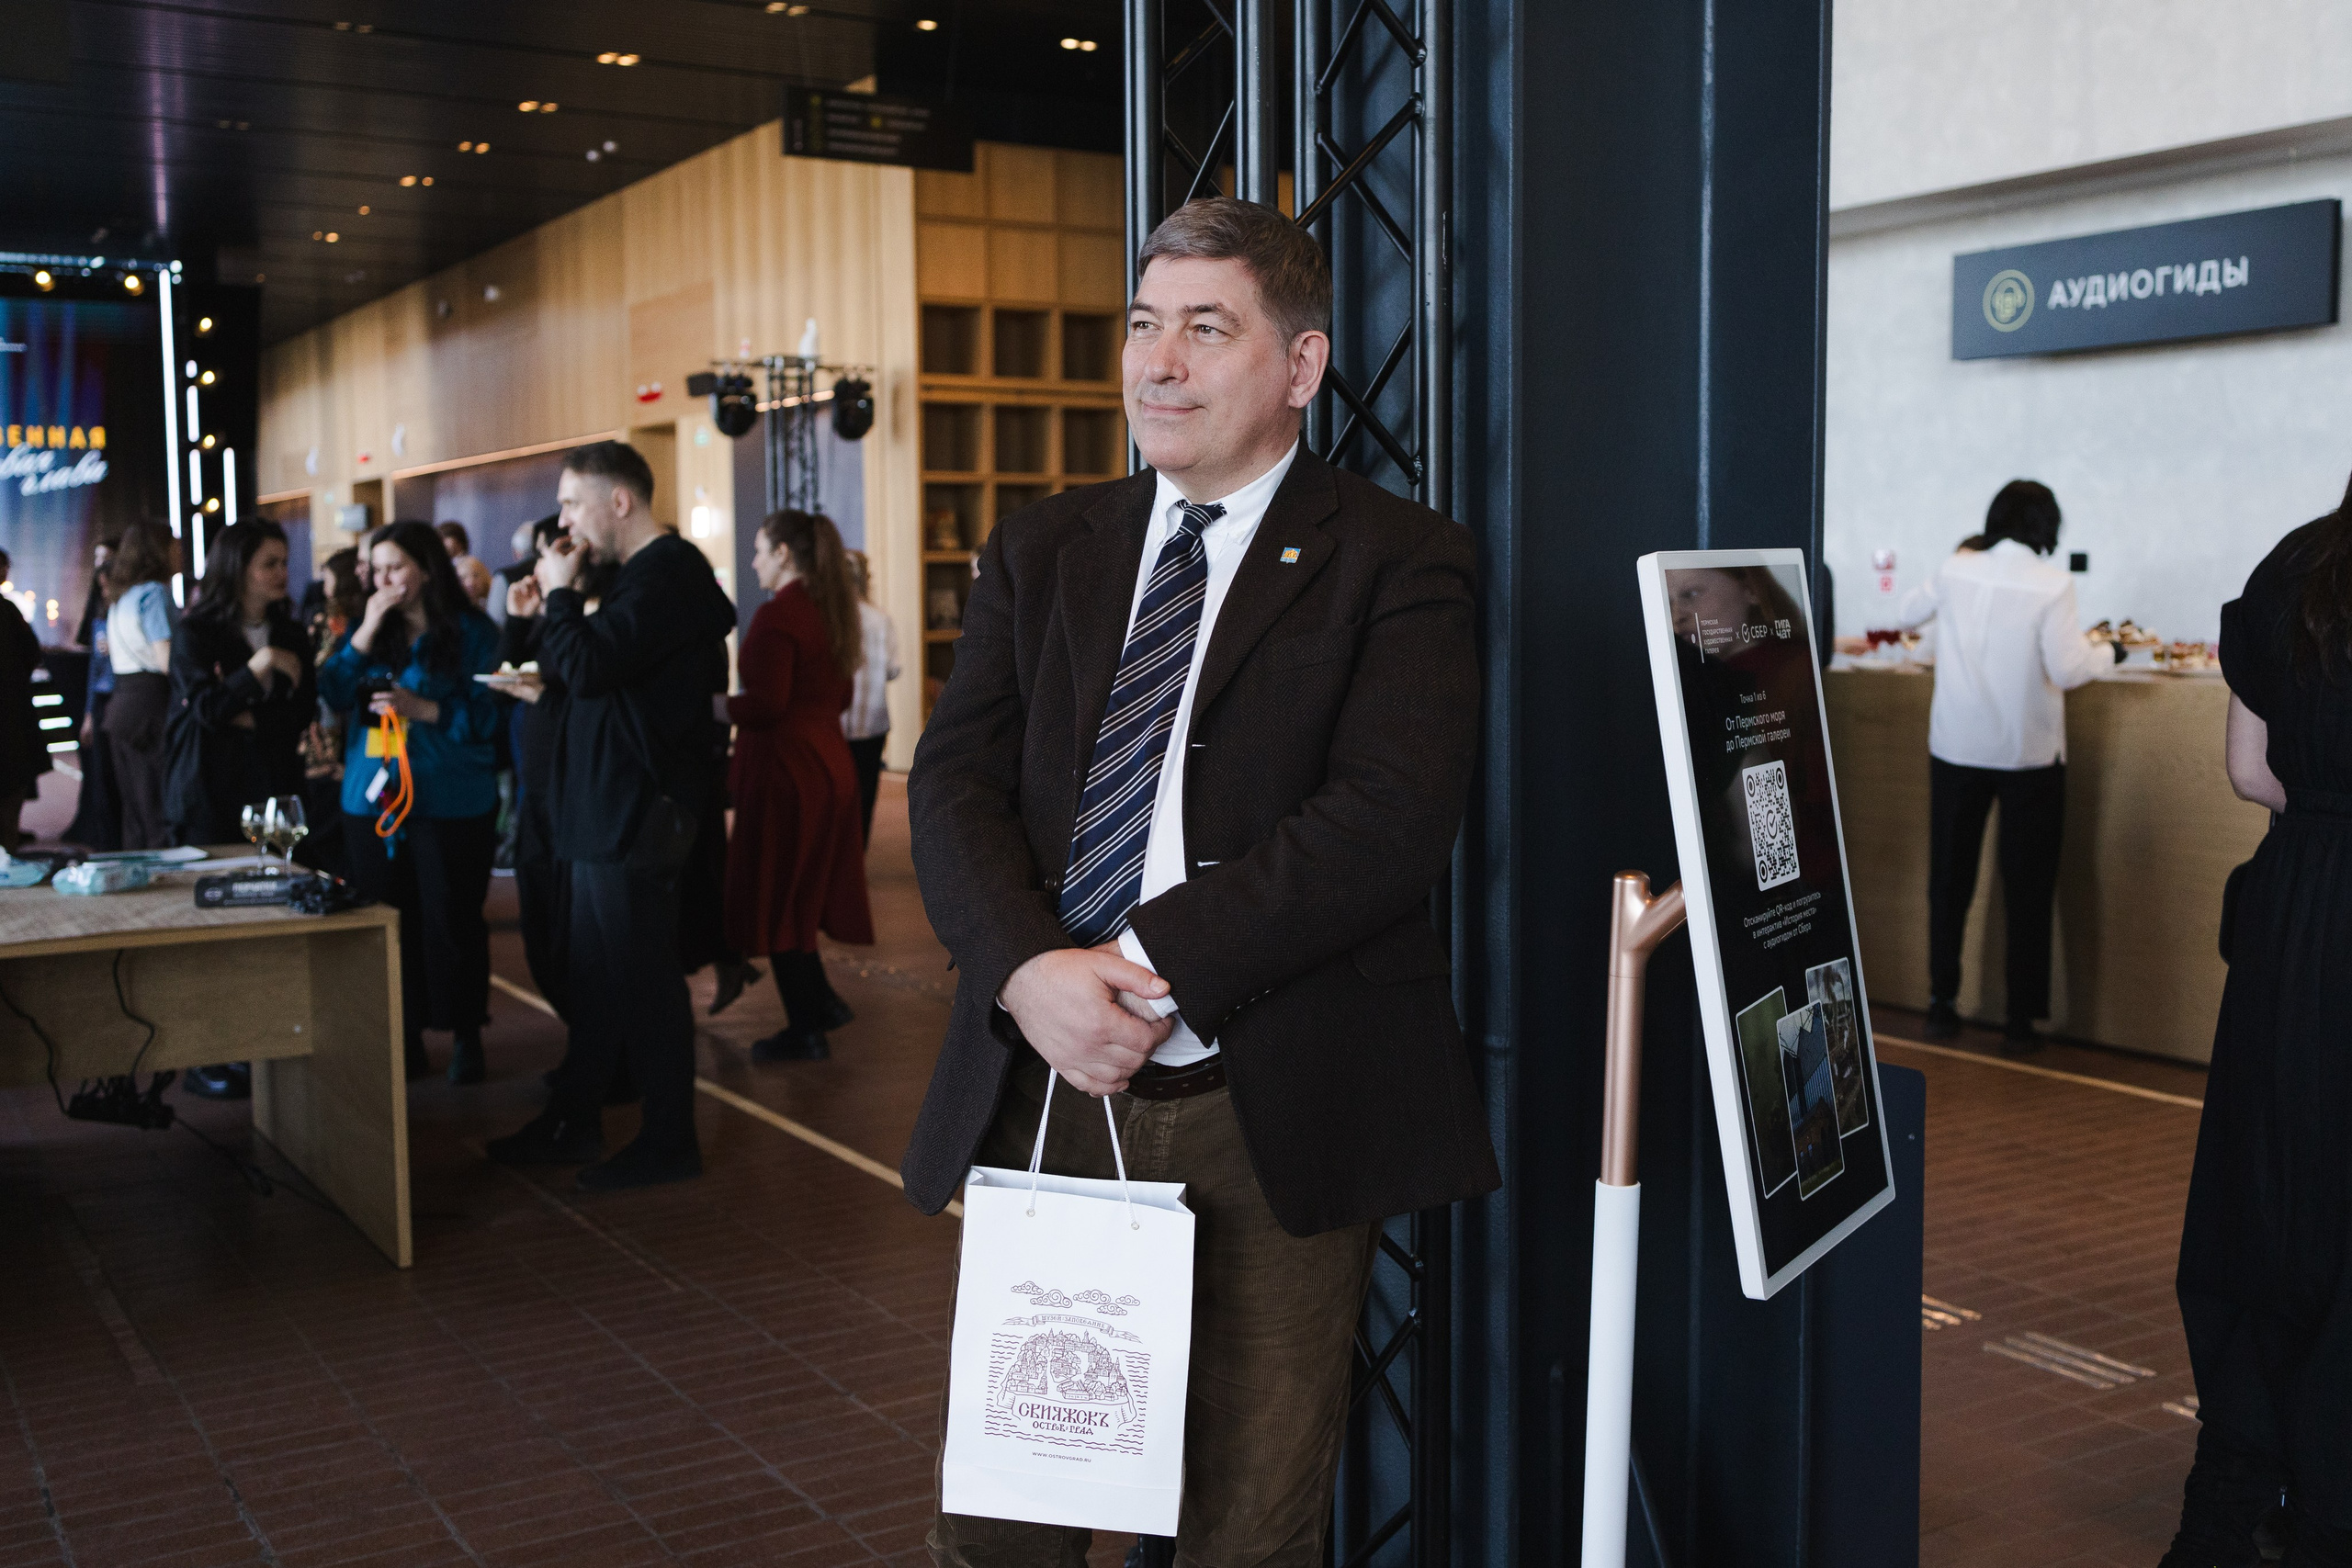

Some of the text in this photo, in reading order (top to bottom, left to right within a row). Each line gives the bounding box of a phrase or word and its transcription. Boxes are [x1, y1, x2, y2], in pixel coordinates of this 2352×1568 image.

[2047, 255, 2250, 310] АУДИОГИДЫ
[0, 424, 106, 449] ЕННАЯ
[1750, 625, 1768, 639] СБЕР
[1774, 618, 1791, 629] ГИГА
[1739, 694, 1754, 704] Точка
[1757, 693, 1762, 701] из
[1762, 690, 1767, 700] 6
[1725, 710, 1786, 731] От Пермского моря
[1726, 728, 1792, 753] до Пермской галереи
[1743, 908, 1776, 928] Отсканируйте
[1775, 902, 1793, 917] QR-код
[1756, 920, 1782, 936] интерактив
[1798, 922, 1812, 934] Сбера
[1018, 1402, 1110, 1427] СВИЯЖСКЪ
[1032, 1451, 1091, 1463] WWW.OSTROVGRAD.RU
